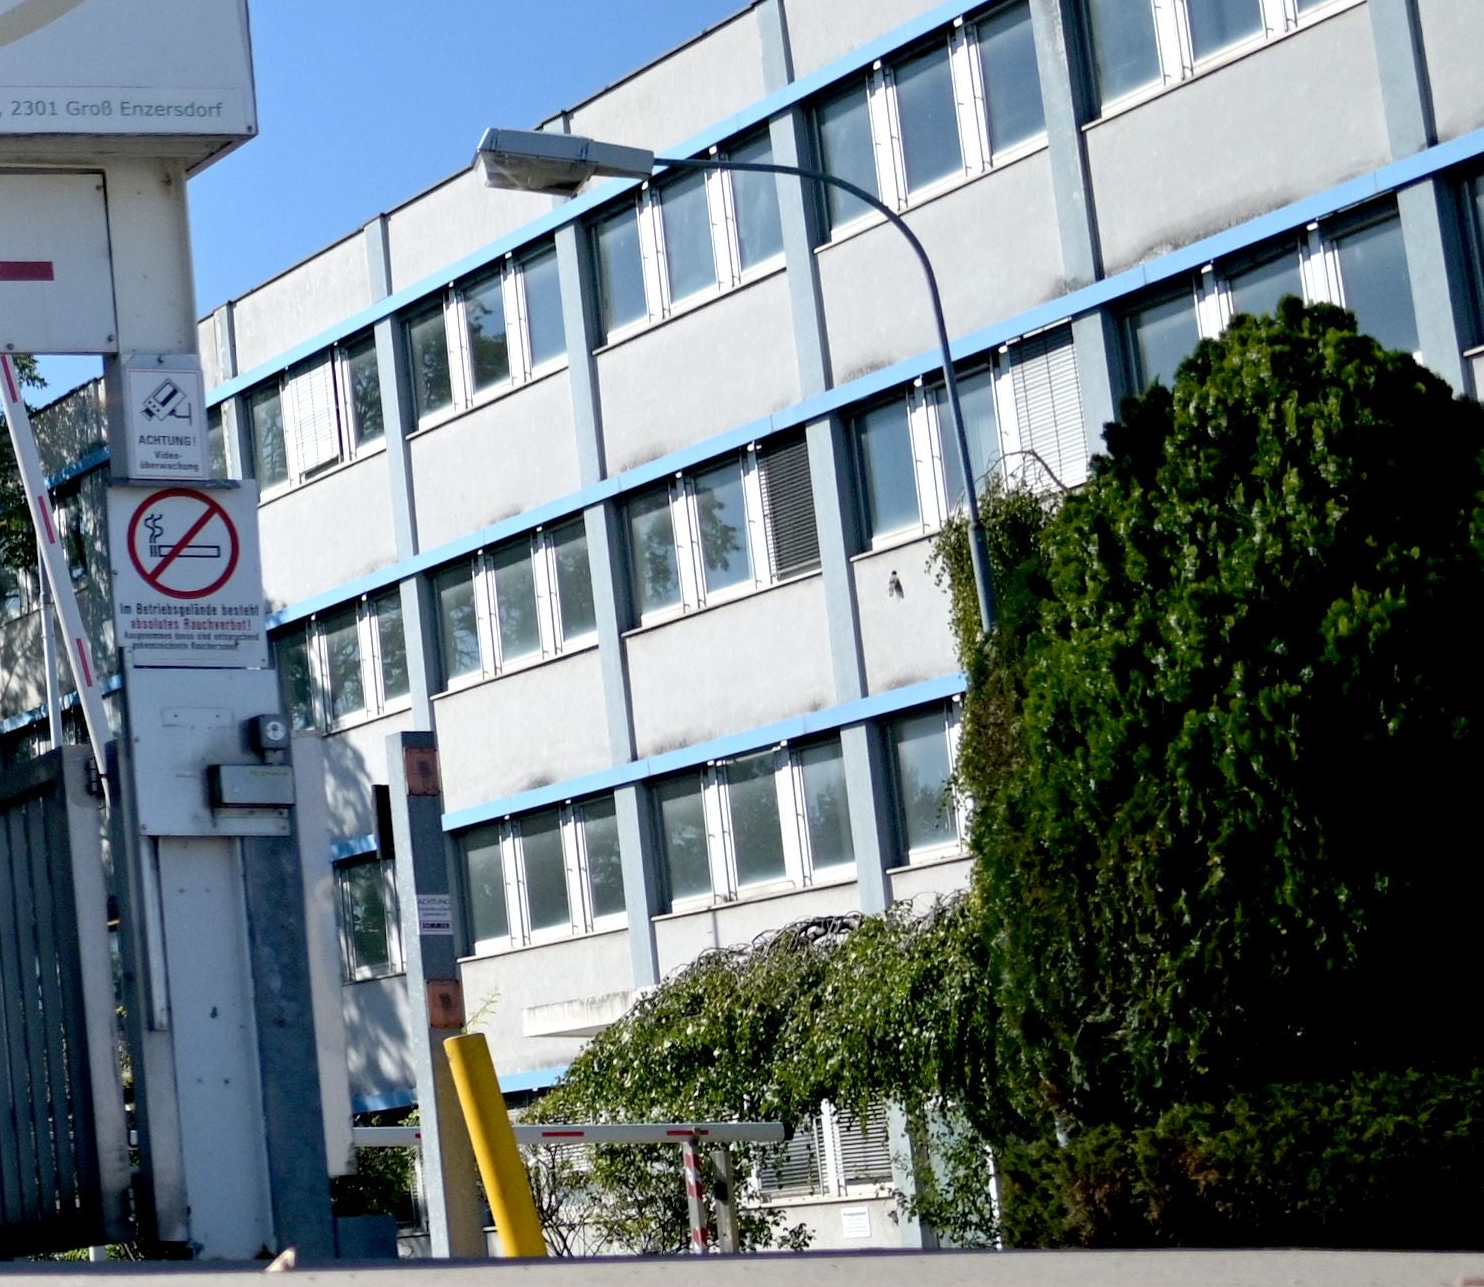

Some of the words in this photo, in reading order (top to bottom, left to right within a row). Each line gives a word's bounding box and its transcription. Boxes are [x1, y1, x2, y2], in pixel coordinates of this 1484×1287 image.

[11, 100, 58, 116] 2301
[66, 100, 113, 116] Groß
[121, 100, 223, 117] Enzersdorf
[154, 450, 184, 460] Video-
[139, 460, 199, 473] überwachung
[119, 603, 132, 615] Im
[136, 602, 218, 618] Betriebsgelände
[221, 603, 259, 616] besteht
[130, 618, 180, 630] absolutes
[184, 618, 252, 631] Rauchverbot!
